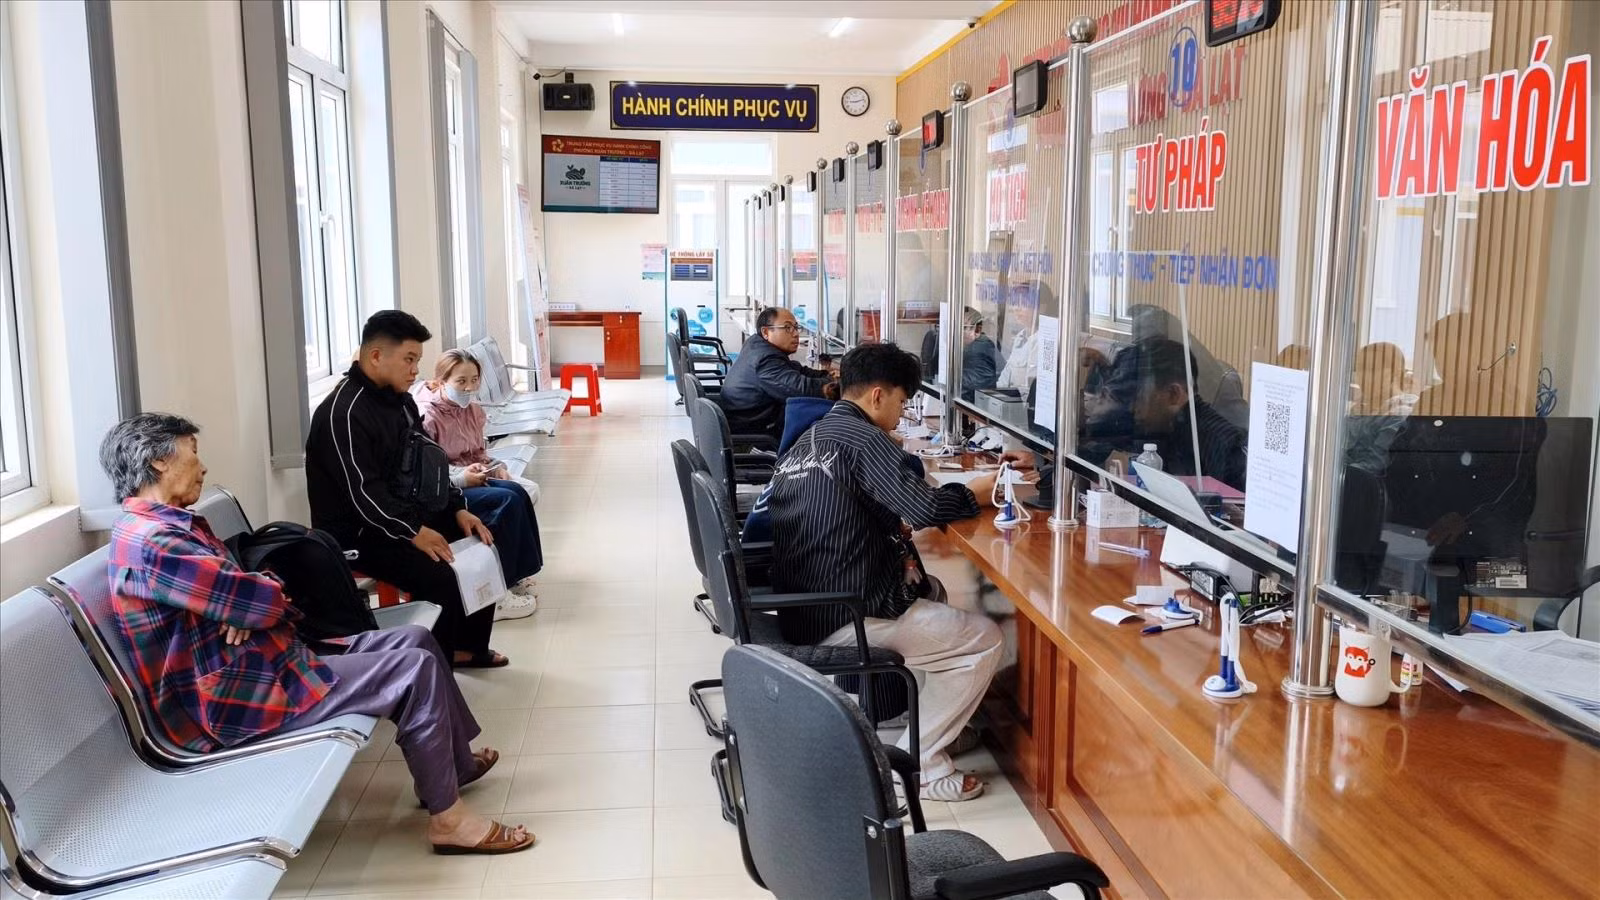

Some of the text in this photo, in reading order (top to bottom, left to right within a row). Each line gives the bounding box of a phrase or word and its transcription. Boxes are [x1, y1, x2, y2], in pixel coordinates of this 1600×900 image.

[622, 92, 807, 122] HÀNH CHÍNH PHỤC VỤ
[1376, 35, 1591, 200] VĂN HÓA
[1135, 115, 1227, 214] TƯ PHÁP
